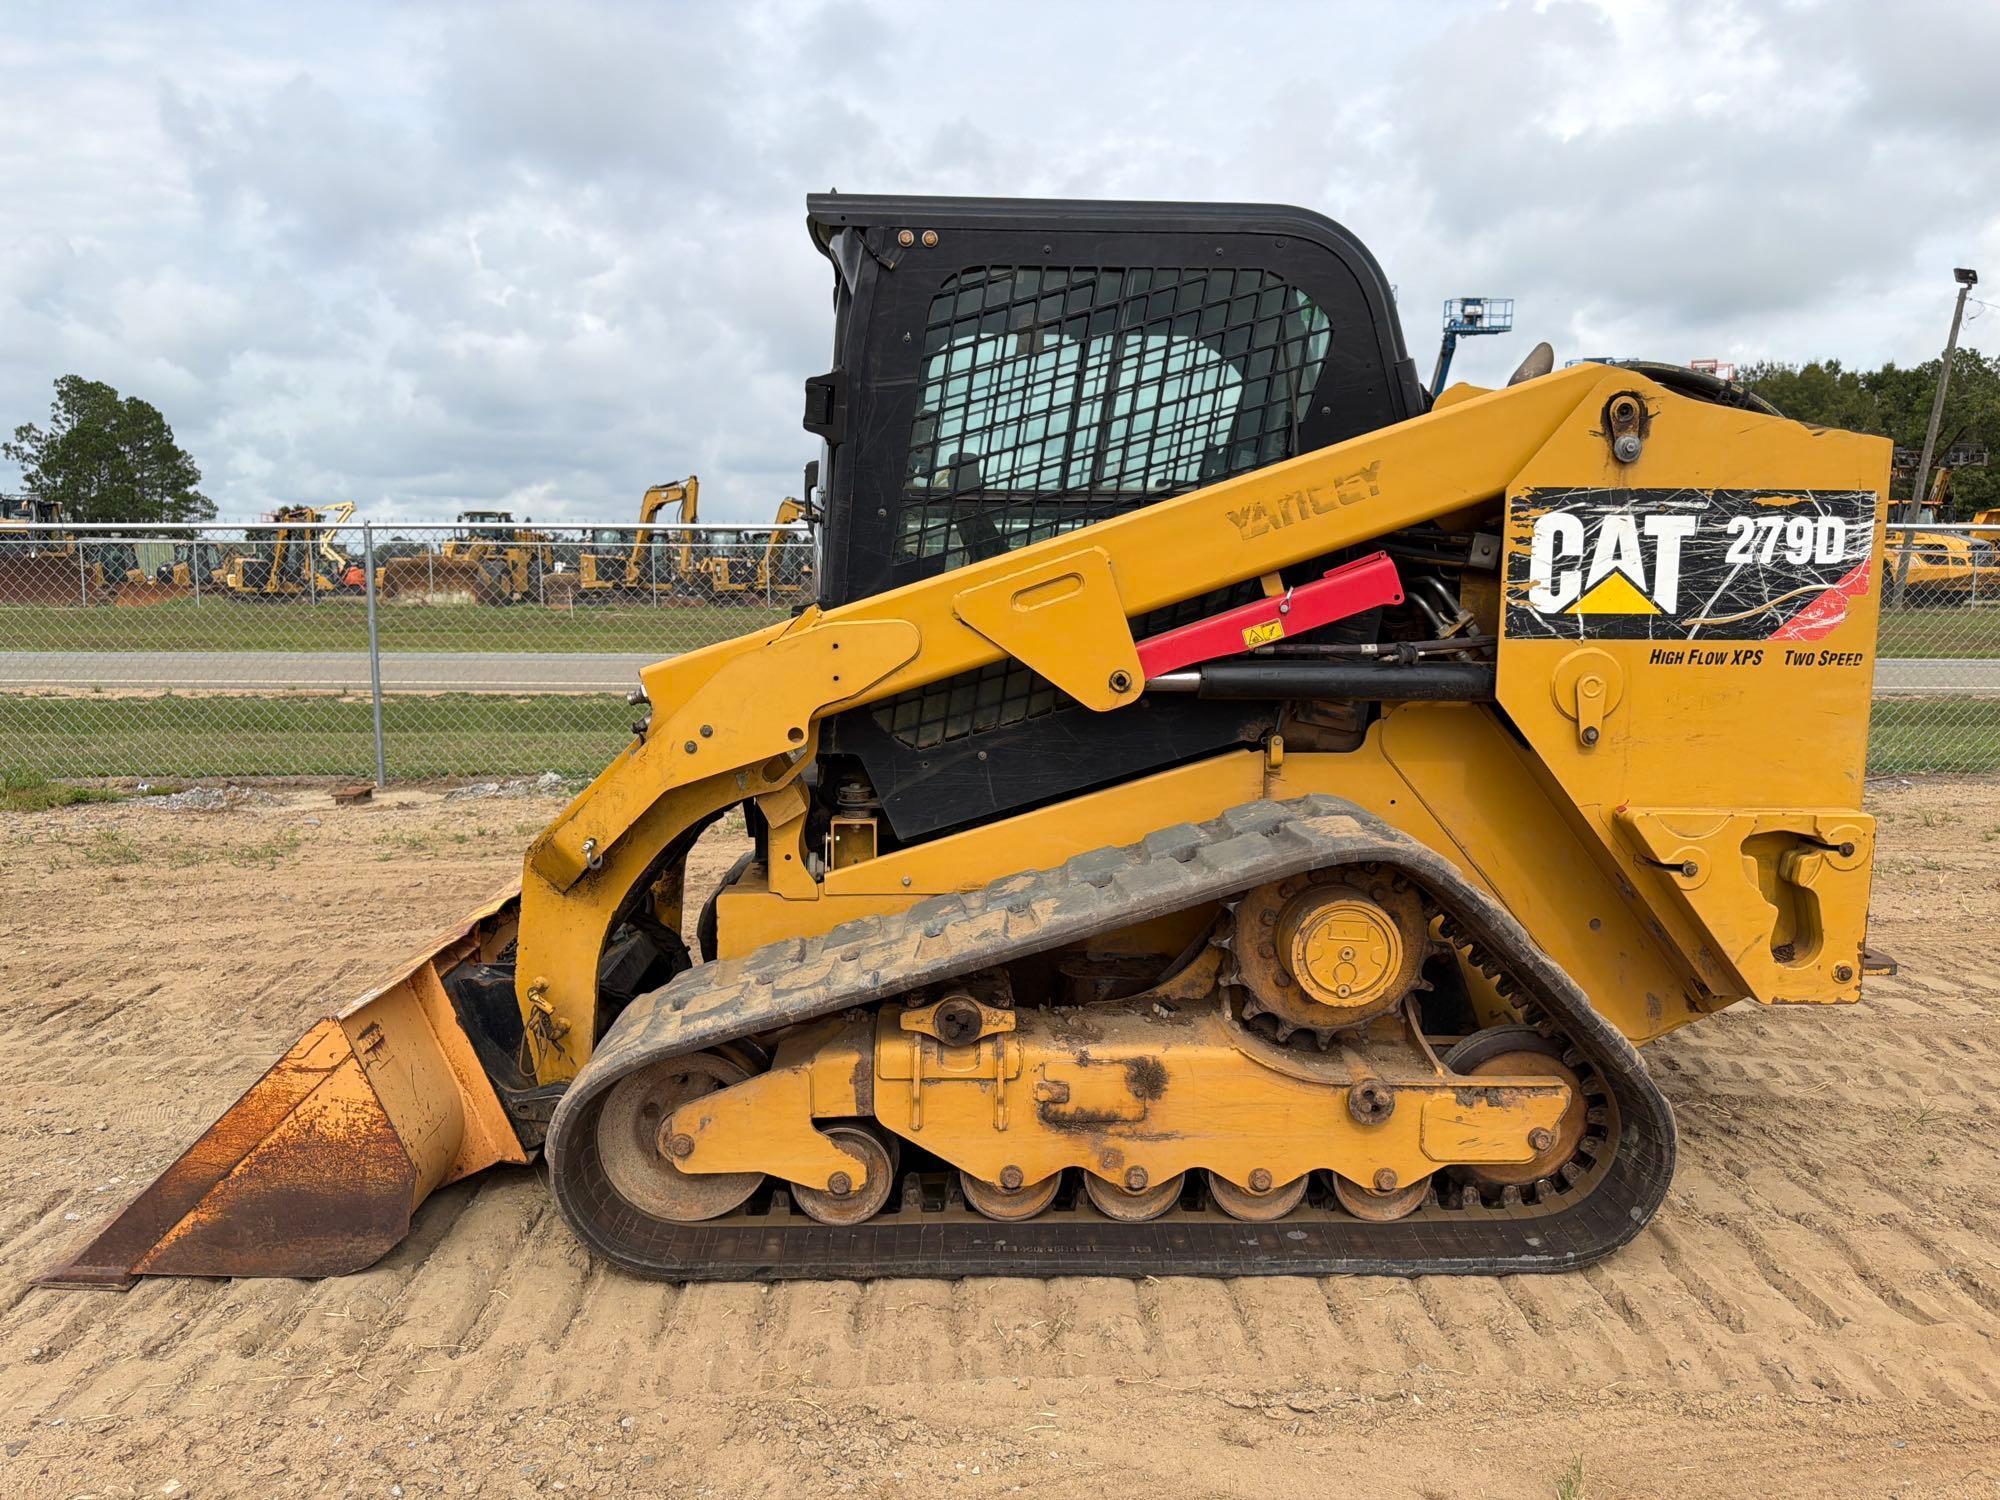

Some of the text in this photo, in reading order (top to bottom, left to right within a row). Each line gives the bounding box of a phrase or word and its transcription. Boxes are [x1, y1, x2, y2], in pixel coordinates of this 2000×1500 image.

[1724, 515, 1846, 565] 279D
[1528, 512, 1697, 614] CAT
[1649, 649, 1764, 666] HIGH FLOW XPS
[1784, 650, 1863, 667] TWO SPEED
